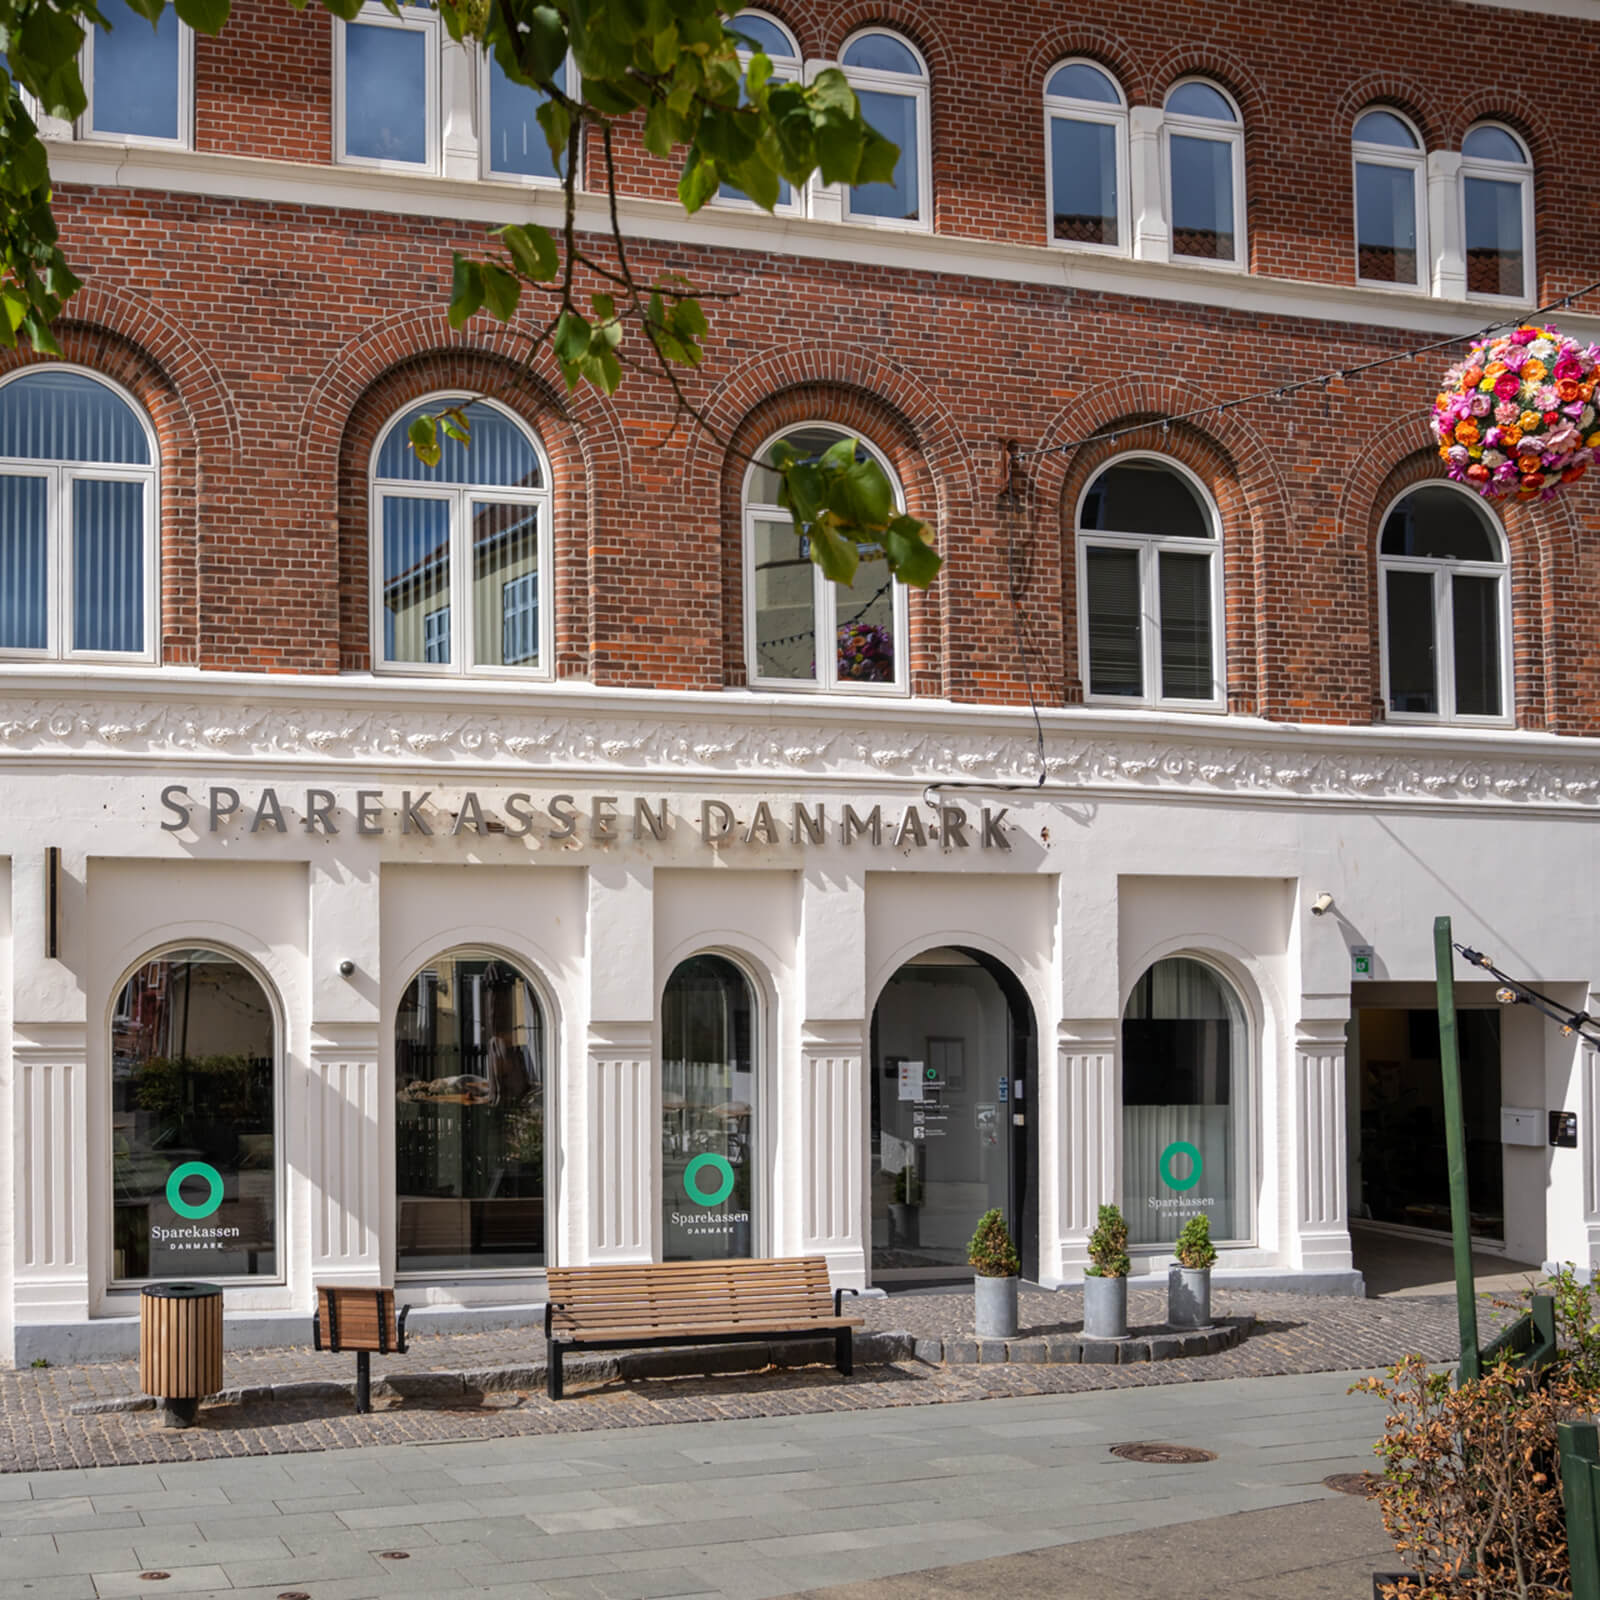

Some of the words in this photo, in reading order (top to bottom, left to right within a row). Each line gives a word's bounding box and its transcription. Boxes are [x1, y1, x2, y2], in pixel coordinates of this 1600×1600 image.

[160, 785, 669, 841] SPAREKASSEN
[700, 799, 1012, 849] DANMARK
[1148, 1196, 1215, 1211] Sparekassen
[671, 1211, 749, 1227] Sparekassen
[151, 1225, 240, 1242] Sparekassen
[687, 1227, 735, 1235] DANMARK
[169, 1242, 224, 1250] DANMARK
